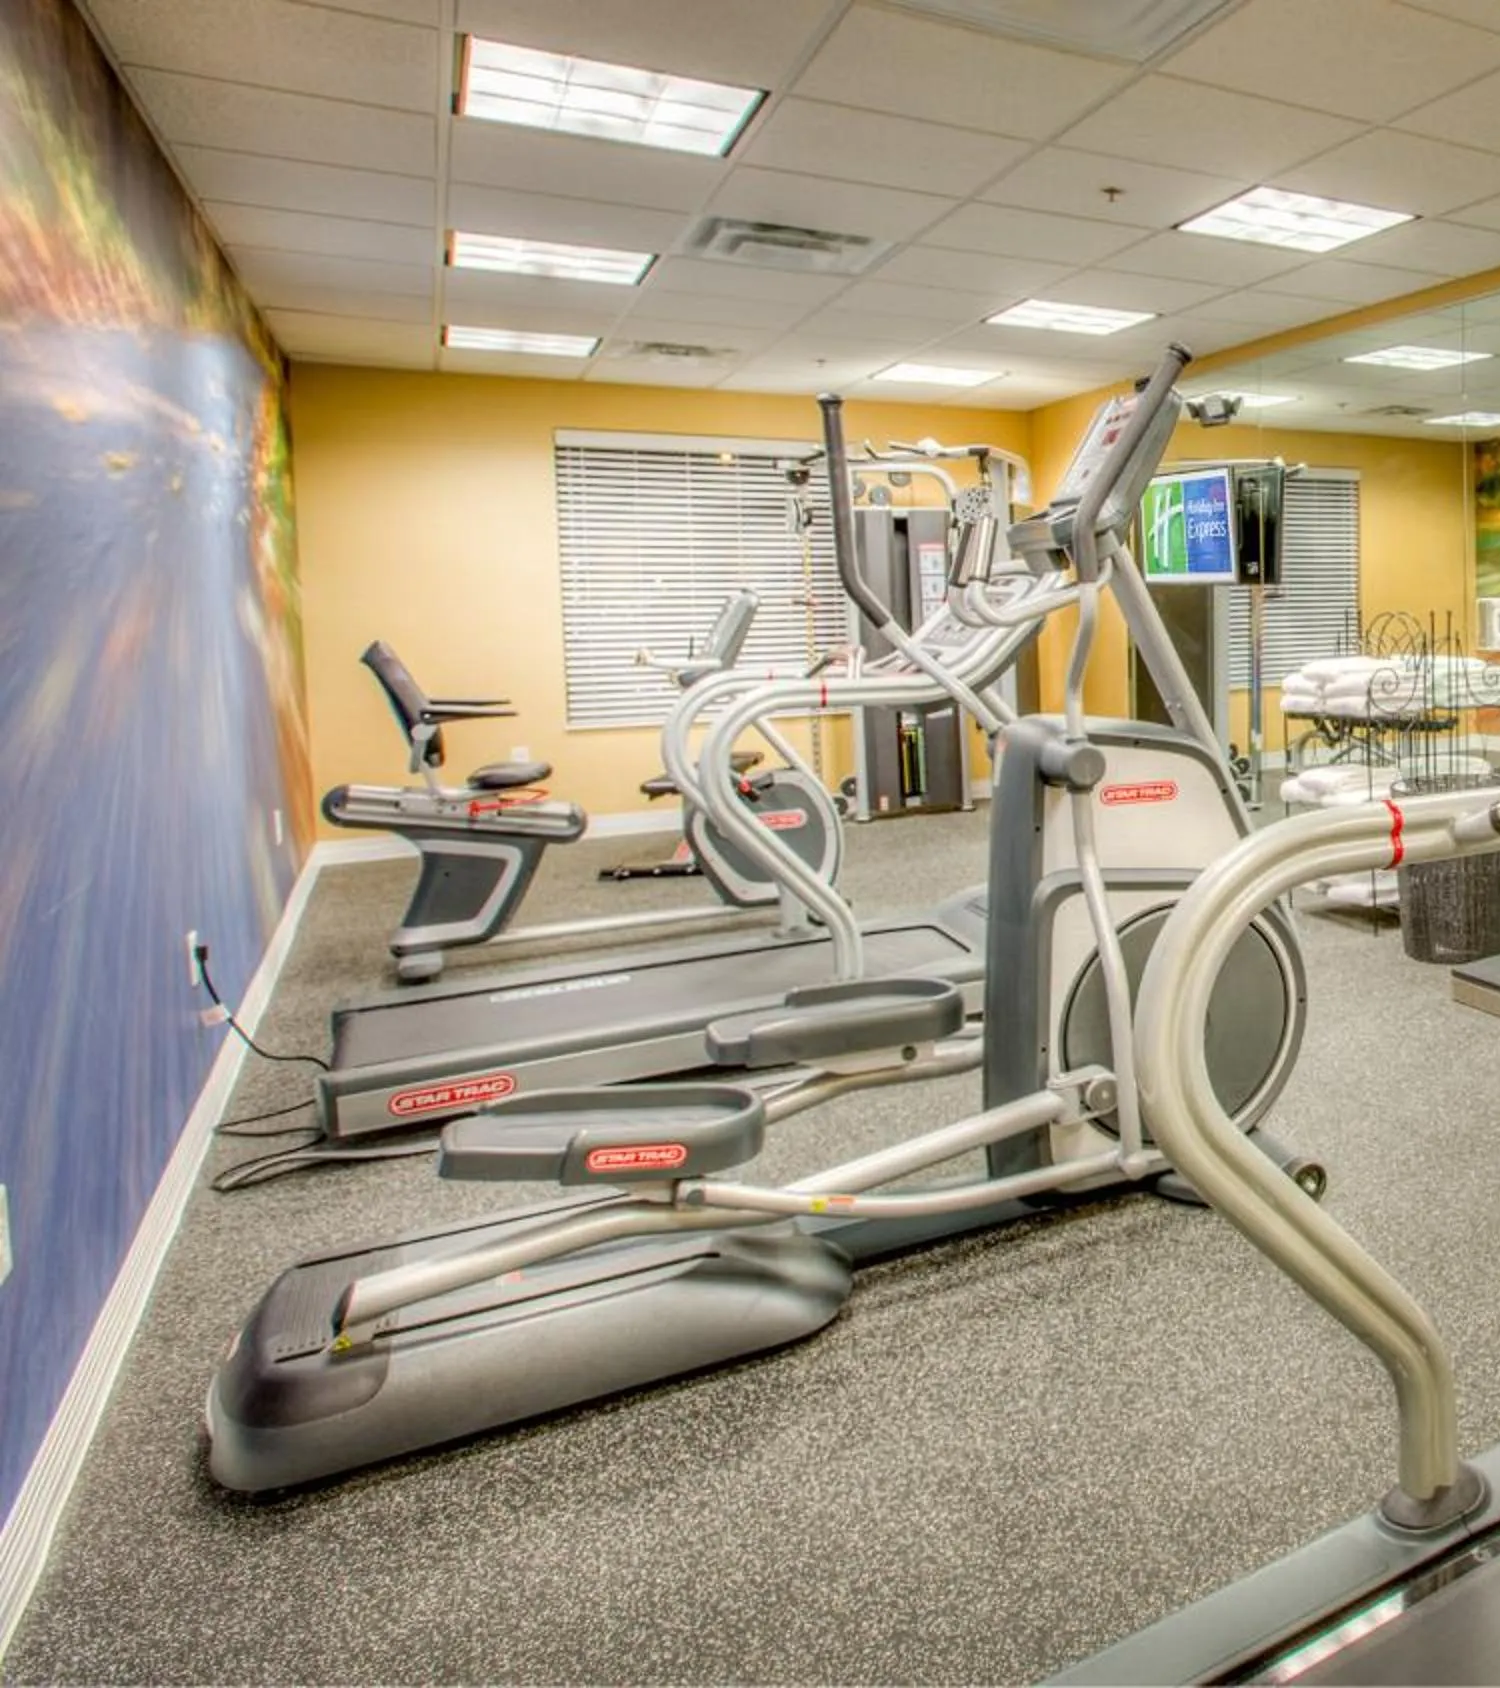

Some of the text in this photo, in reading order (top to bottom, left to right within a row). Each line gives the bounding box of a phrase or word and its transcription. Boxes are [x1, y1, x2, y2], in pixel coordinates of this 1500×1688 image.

[1187, 518, 1227, 543] Express
[400, 1079, 507, 1111] STAR TRAC
[594, 1147, 679, 1166] STAR TRAC
